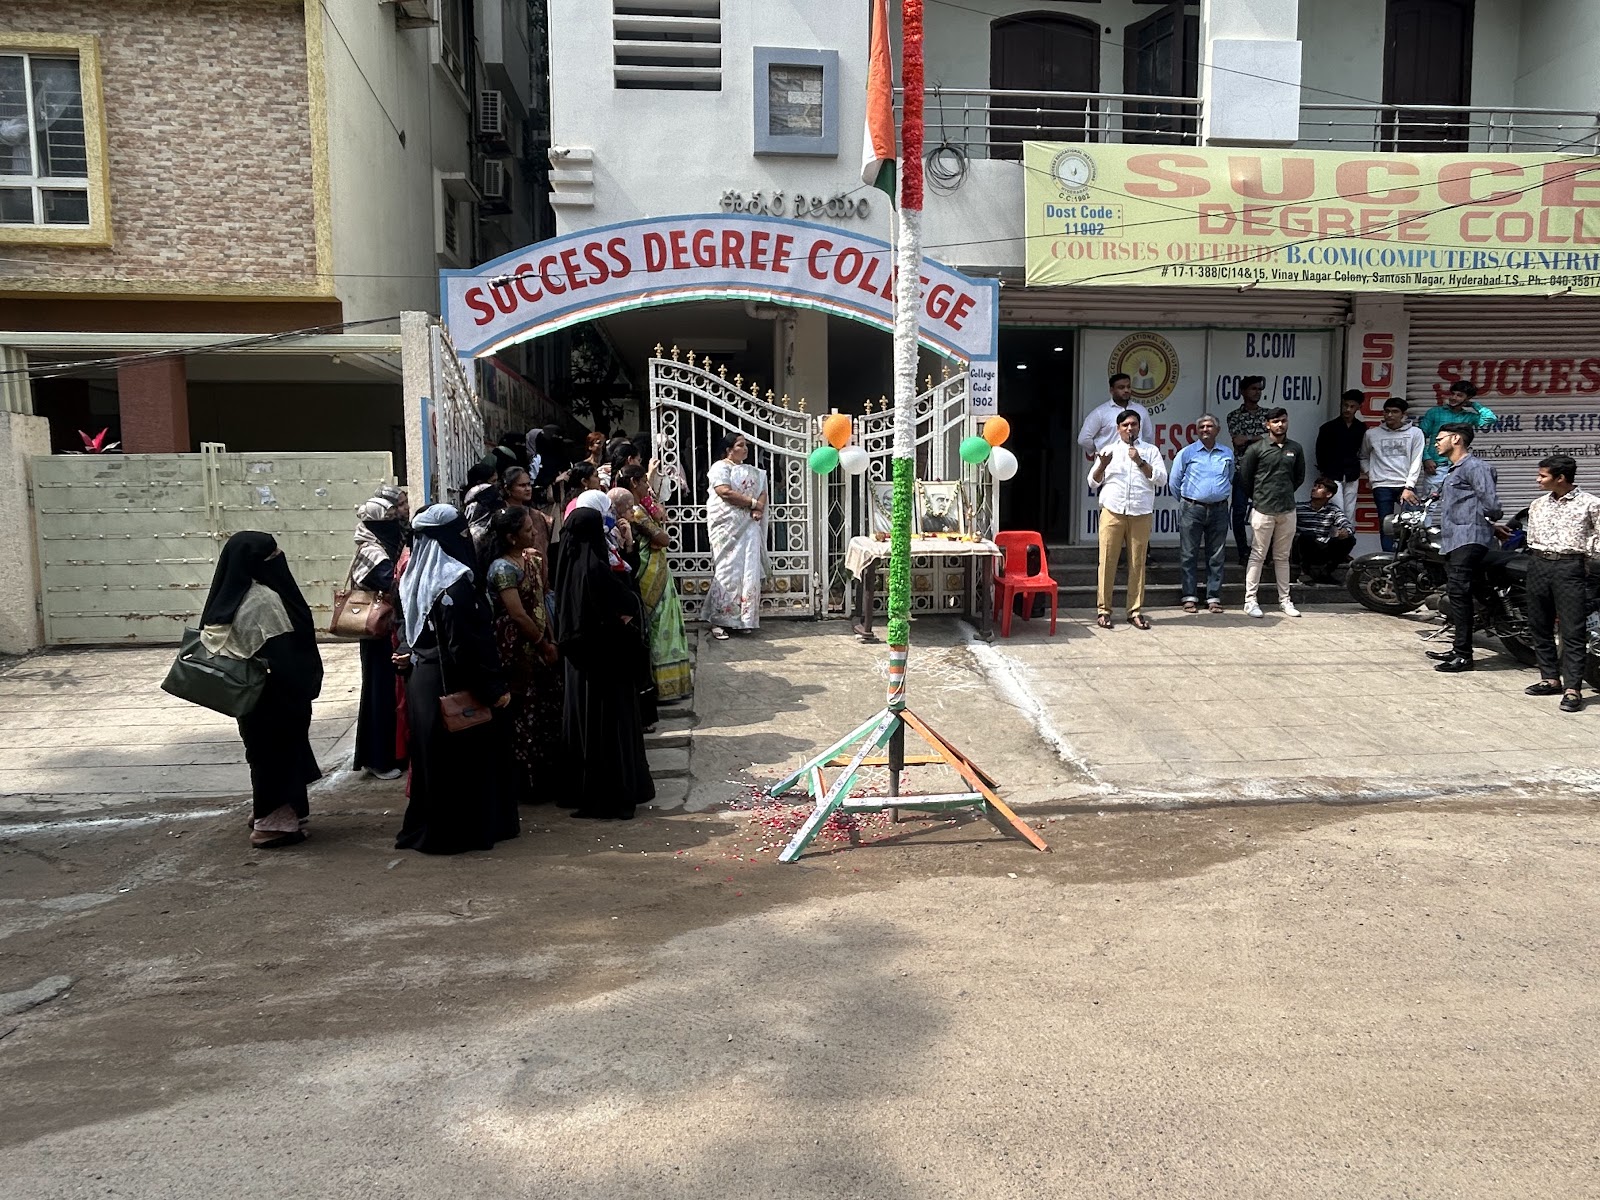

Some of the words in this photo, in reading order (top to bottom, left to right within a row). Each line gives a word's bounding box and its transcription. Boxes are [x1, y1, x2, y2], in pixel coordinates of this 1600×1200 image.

[1046, 205, 1077, 218] Dost
[1081, 205, 1113, 219] Code
[1064, 222, 1105, 236] 11902
[1199, 203, 1431, 242] DEGREE
[1459, 208, 1600, 244] COLL
[1051, 241, 1160, 261] COURSES
[1167, 243, 1279, 264] OFFERED:
[465, 237, 632, 326] SUCCESS
[643, 229, 794, 273] DEGREE
[808, 239, 977, 332] COLLGE
[1271, 268, 1299, 281] Vinay
[1302, 269, 1331, 283] Nagar
[1334, 270, 1369, 285] Colony,
[1372, 272, 1411, 284] Santosh
[1414, 272, 1445, 286] Nagar,
[1118, 334, 1160, 352] EDUCATIONAL
[1246, 332, 1296, 358] B.COM
[971, 368, 995, 380] College
[972, 382, 992, 392] Code
[1283, 375, 1322, 405] GEN.)
[972, 397, 993, 407] 1902
[1534, 413, 1600, 431] INSTIT
